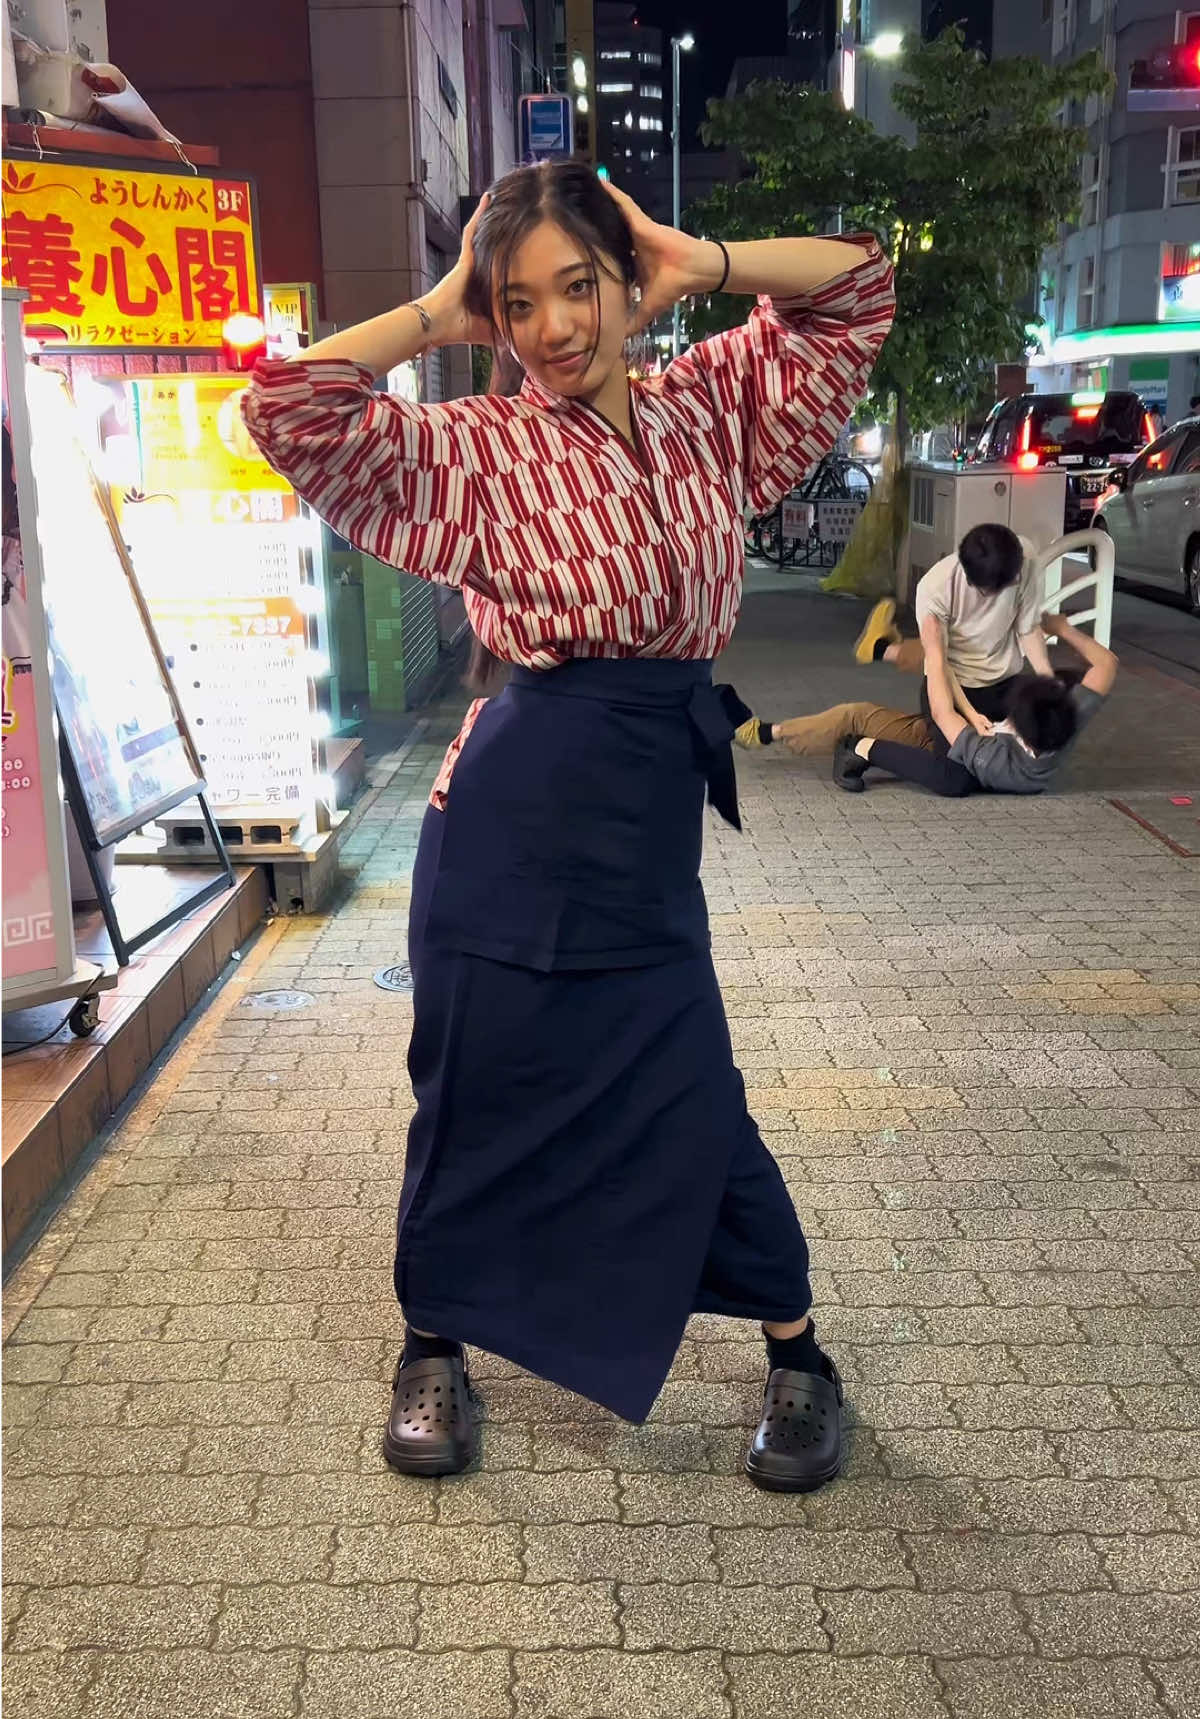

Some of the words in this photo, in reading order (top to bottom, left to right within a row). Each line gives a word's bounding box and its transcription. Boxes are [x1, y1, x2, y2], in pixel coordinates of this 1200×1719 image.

[90, 177, 209, 213] ようしんかく
[217, 189, 244, 212] 3F
[70, 324, 197, 345] リラクゼーション
